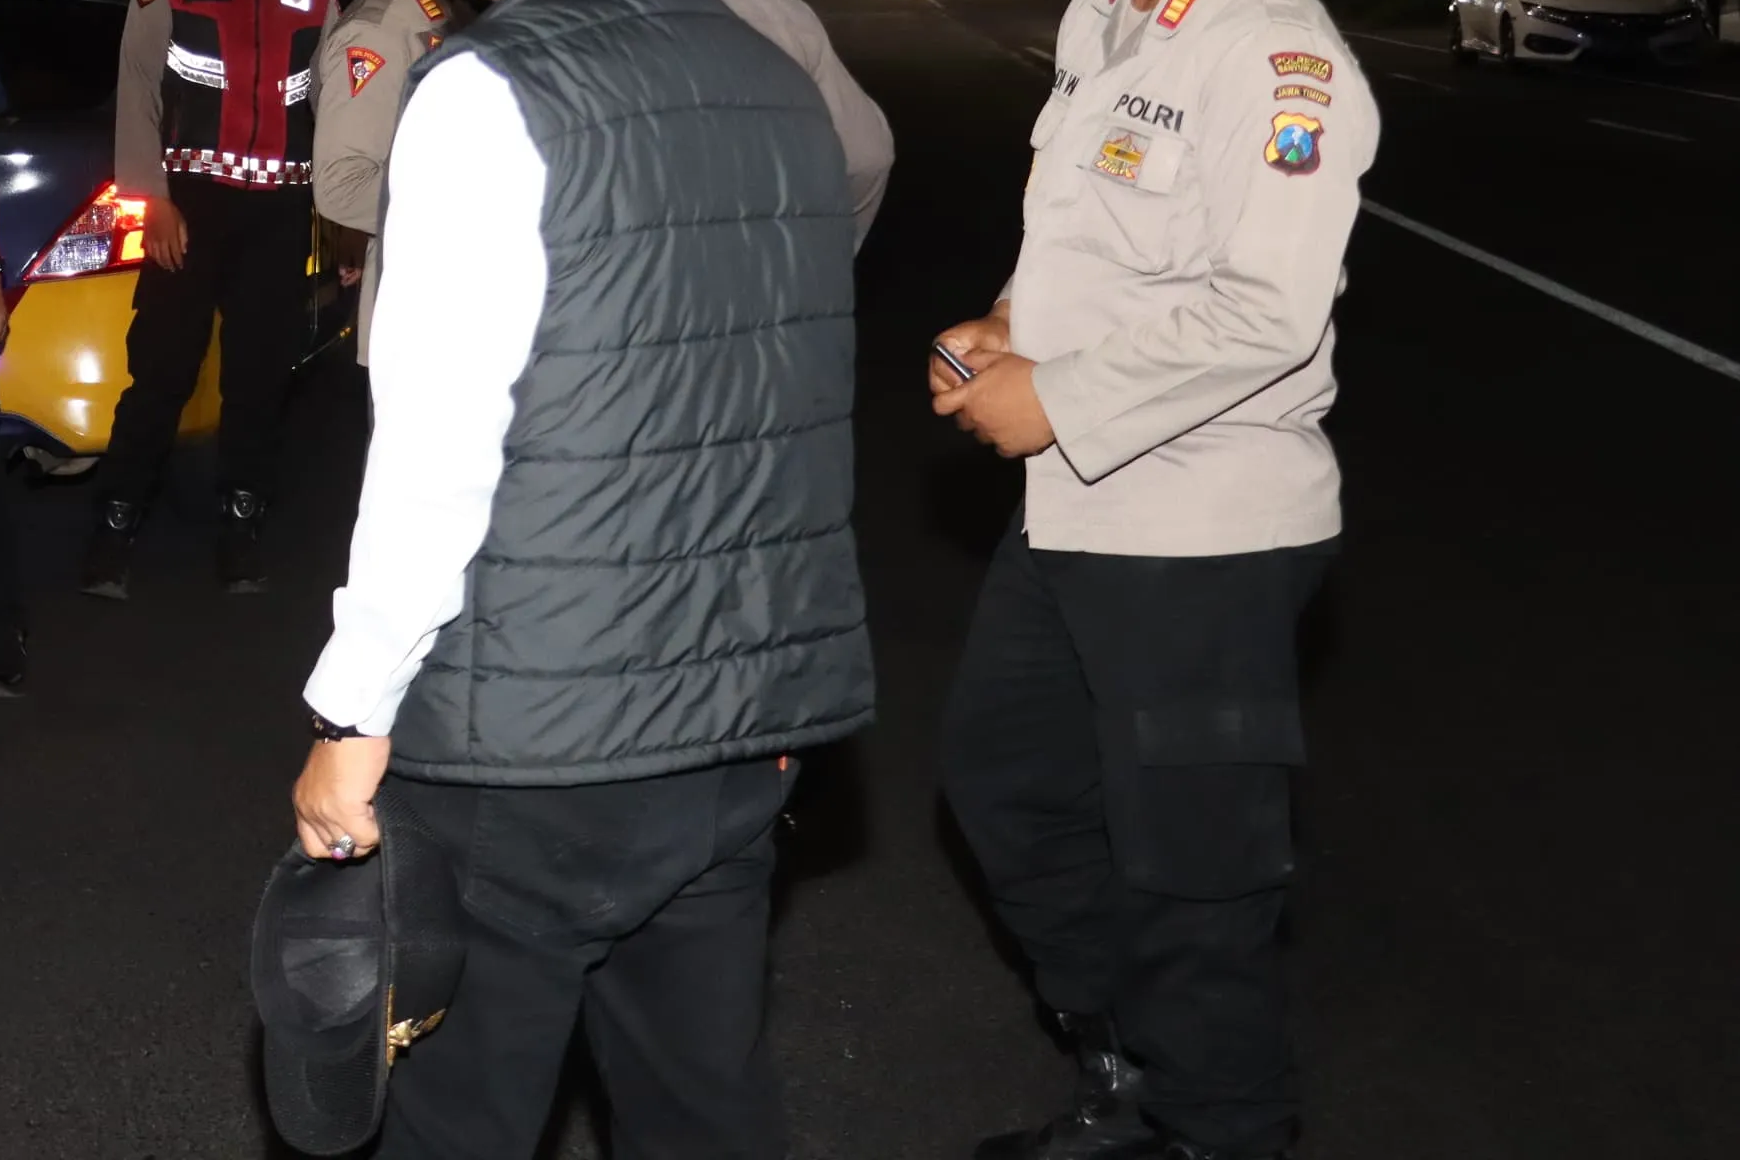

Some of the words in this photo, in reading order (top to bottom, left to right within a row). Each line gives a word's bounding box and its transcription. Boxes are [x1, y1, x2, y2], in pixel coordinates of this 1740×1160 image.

[1276, 87, 1300, 98] JAWA
[1302, 88, 1329, 104] TIMUR
[1112, 94, 1184, 132] POLRI
